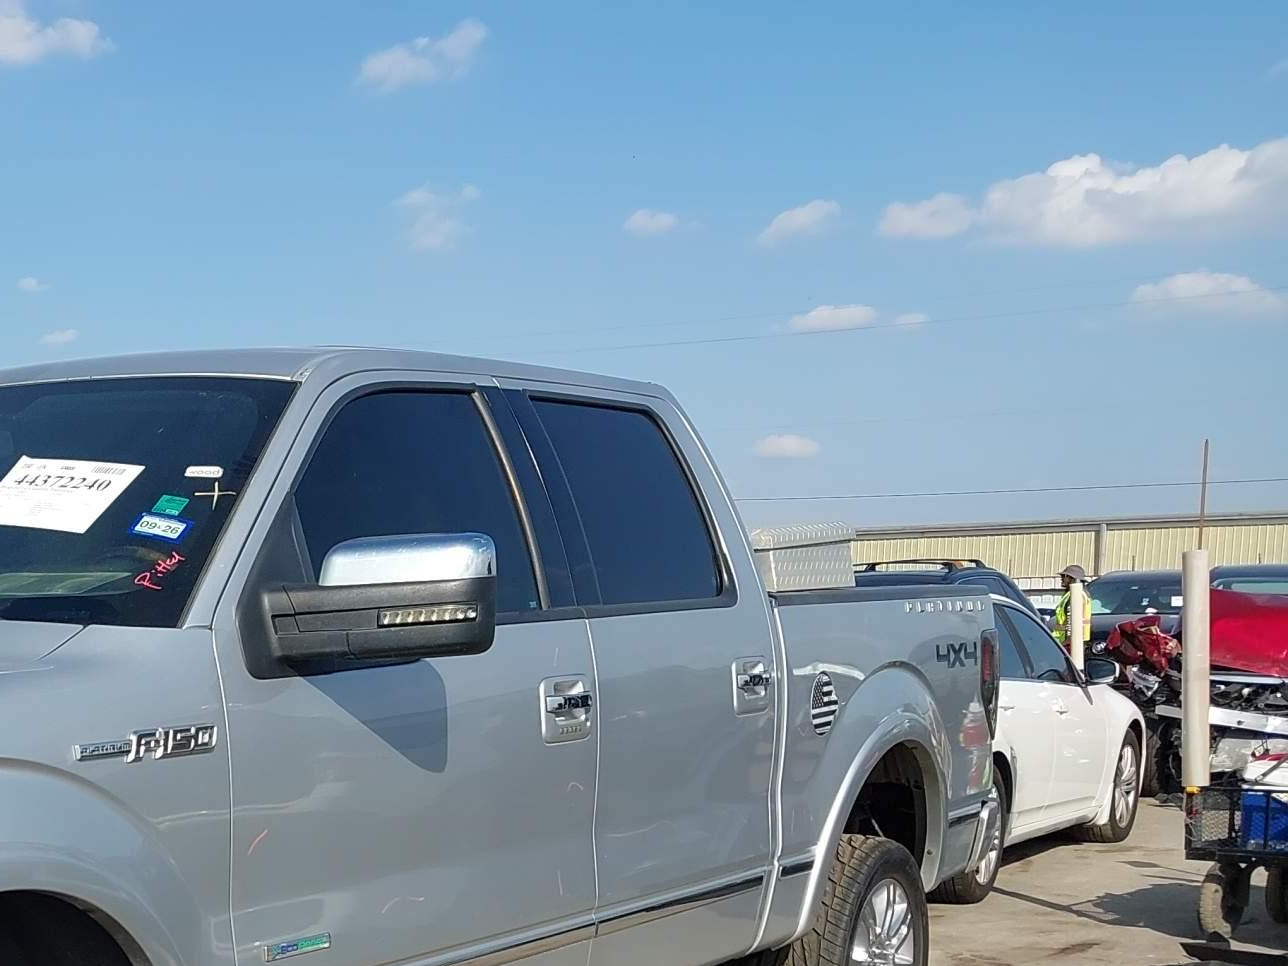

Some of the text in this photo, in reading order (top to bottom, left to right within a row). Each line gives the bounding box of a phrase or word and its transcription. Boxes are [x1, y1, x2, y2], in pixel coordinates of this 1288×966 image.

[13, 473, 112, 492] 44372240
[139, 520, 181, 535] 09 26
